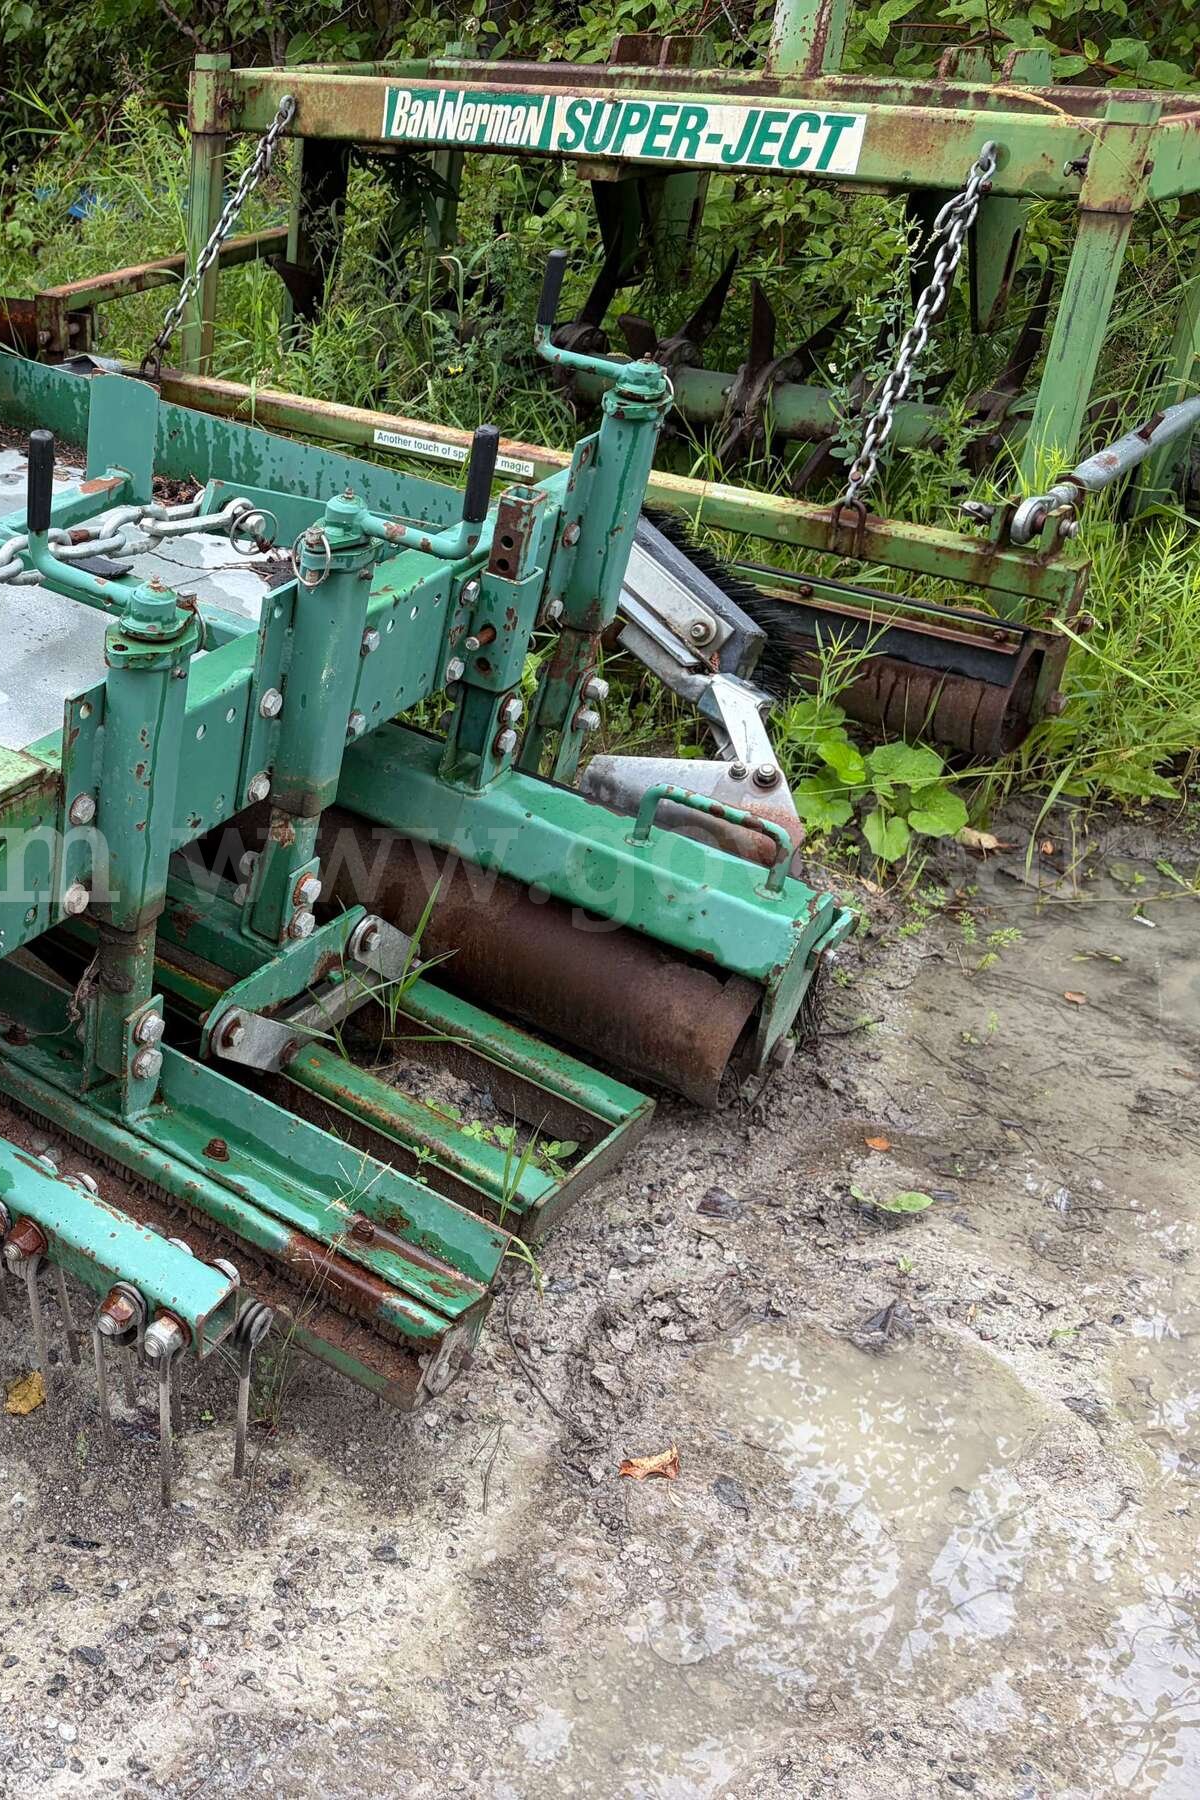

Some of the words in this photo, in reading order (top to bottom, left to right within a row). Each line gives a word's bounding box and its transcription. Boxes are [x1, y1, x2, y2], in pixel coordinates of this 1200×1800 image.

[557, 98, 856, 171] SUPER-JECT
[377, 431, 413, 449] Another
[414, 439, 439, 453] touch
[441, 446, 452, 457] of
[501, 459, 531, 474] magic
